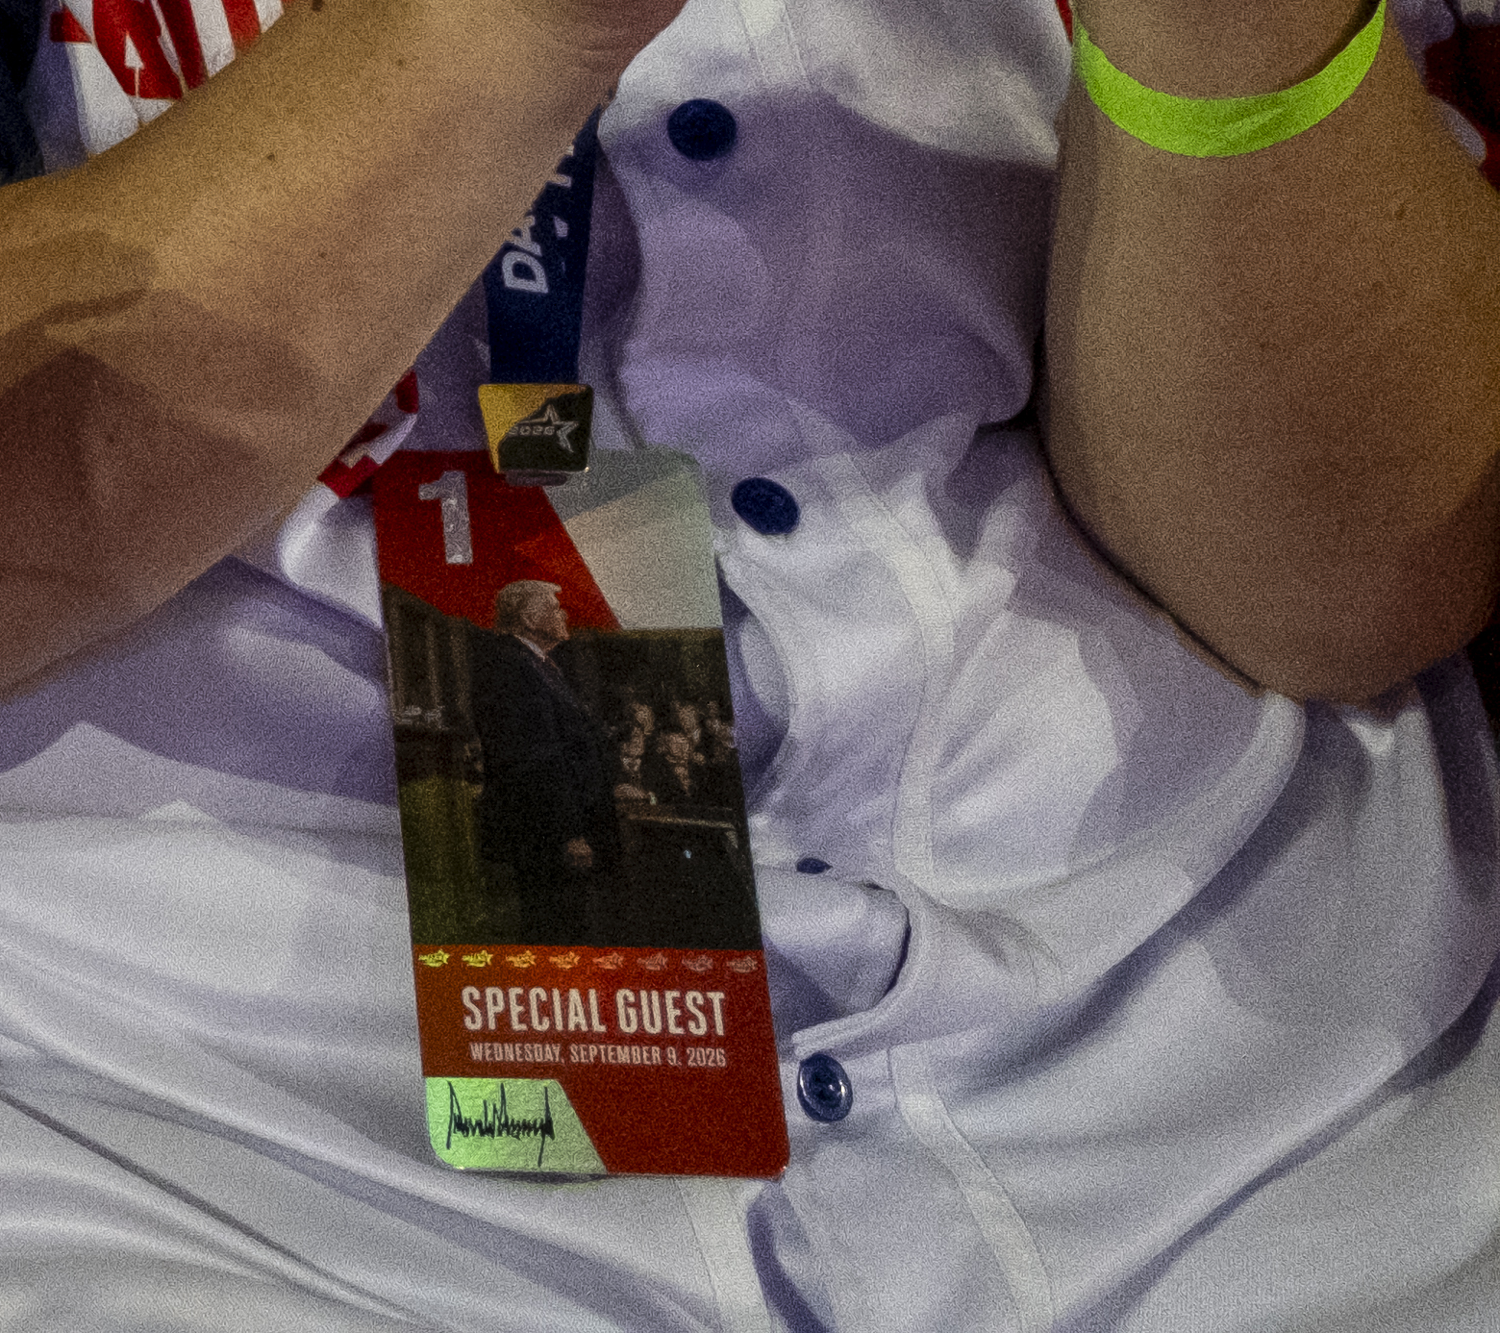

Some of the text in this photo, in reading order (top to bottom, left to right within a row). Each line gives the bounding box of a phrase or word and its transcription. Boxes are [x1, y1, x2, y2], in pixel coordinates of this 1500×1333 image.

[418, 470, 473, 565] 1
[461, 985, 727, 1037] SPECIAL GUEST
[469, 1041, 566, 1065] WEDNESDAY,
[568, 1043, 662, 1066] SEPTEMBER
[686, 1047, 727, 1068] 2026
